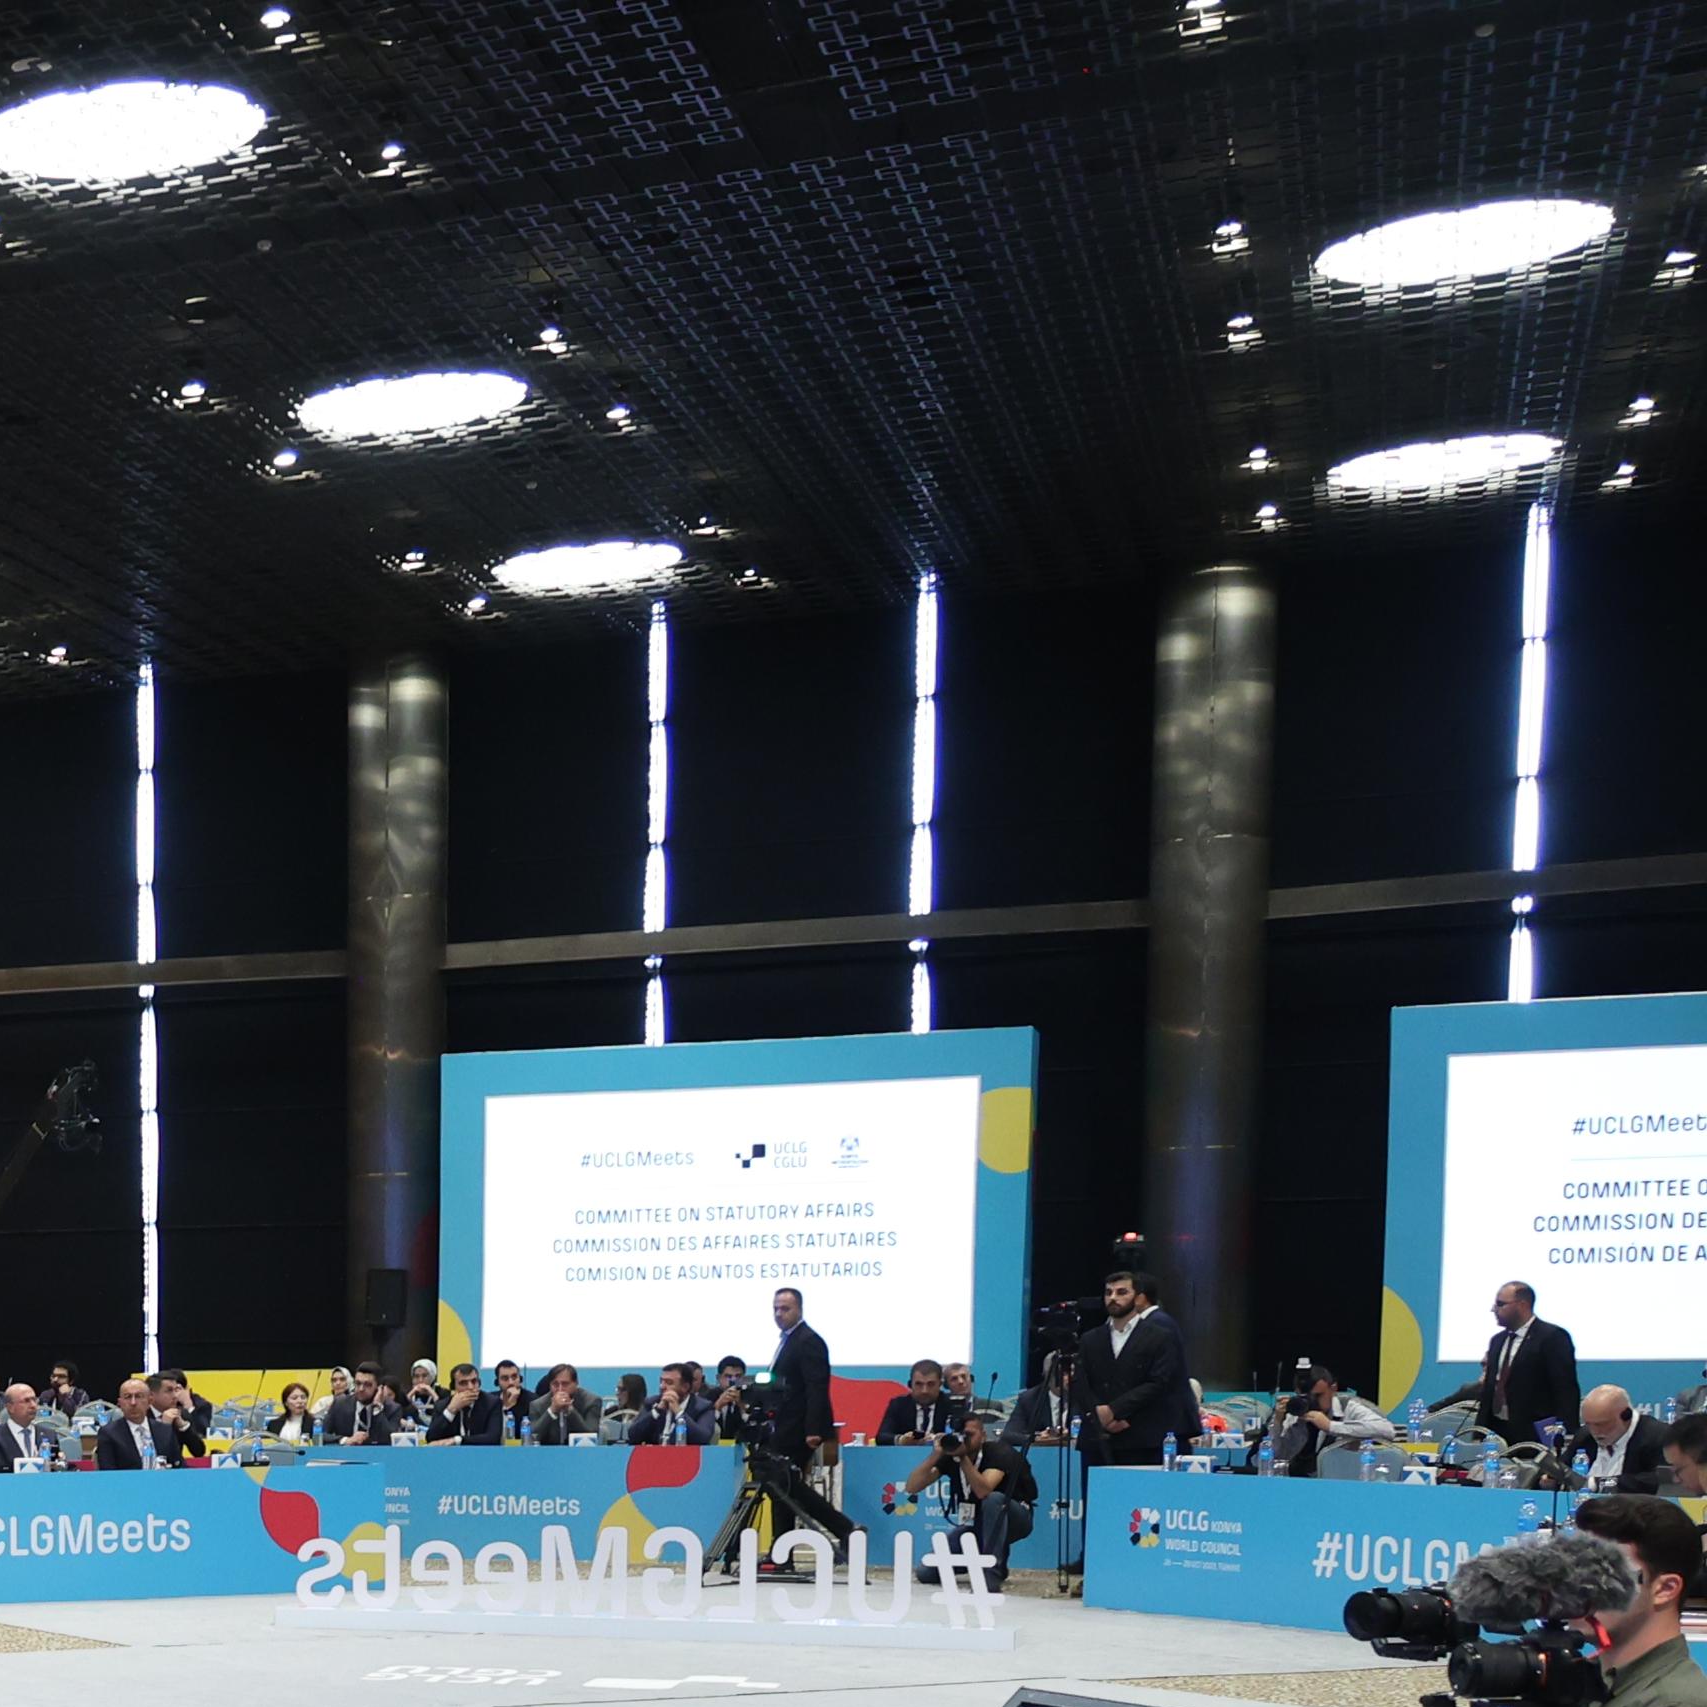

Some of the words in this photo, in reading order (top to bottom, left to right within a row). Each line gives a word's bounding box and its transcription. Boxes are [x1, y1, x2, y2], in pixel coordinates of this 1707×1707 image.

[773, 1141, 807, 1155] UCLG
[580, 1150, 694, 1169] #UCLGMeets
[773, 1156, 807, 1169] CGLU
[1563, 1179, 1691, 1200] COMMITTEE
[575, 1207, 673, 1226] COMMITTEE
[678, 1206, 701, 1222] ON
[706, 1204, 800, 1222] STATUTORY
[804, 1201, 875, 1219] AFFAIRS
[1533, 1212, 1675, 1233] COMMISSION
[552, 1235, 662, 1254] COMMISSION
[667, 1235, 697, 1252] DES
[702, 1233, 781, 1250] AFFAIRES
[785, 1230, 898, 1249] STATUTAIRES
[1662, 1245, 1689, 1263] DE
[652, 1265, 673, 1281] DE
[677, 1262, 755, 1281] ASUNTOS
[760, 1260, 883, 1279] ESTATUTARIOS
[437, 1494, 581, 1516] #UCLGMeets
[1165, 1508, 1210, 1532] UCLG
[1210, 1520, 1243, 1535] KONYA
[1164, 1538, 1199, 1553] WORLD
[1200, 1541, 1242, 1556] COUNCIL
